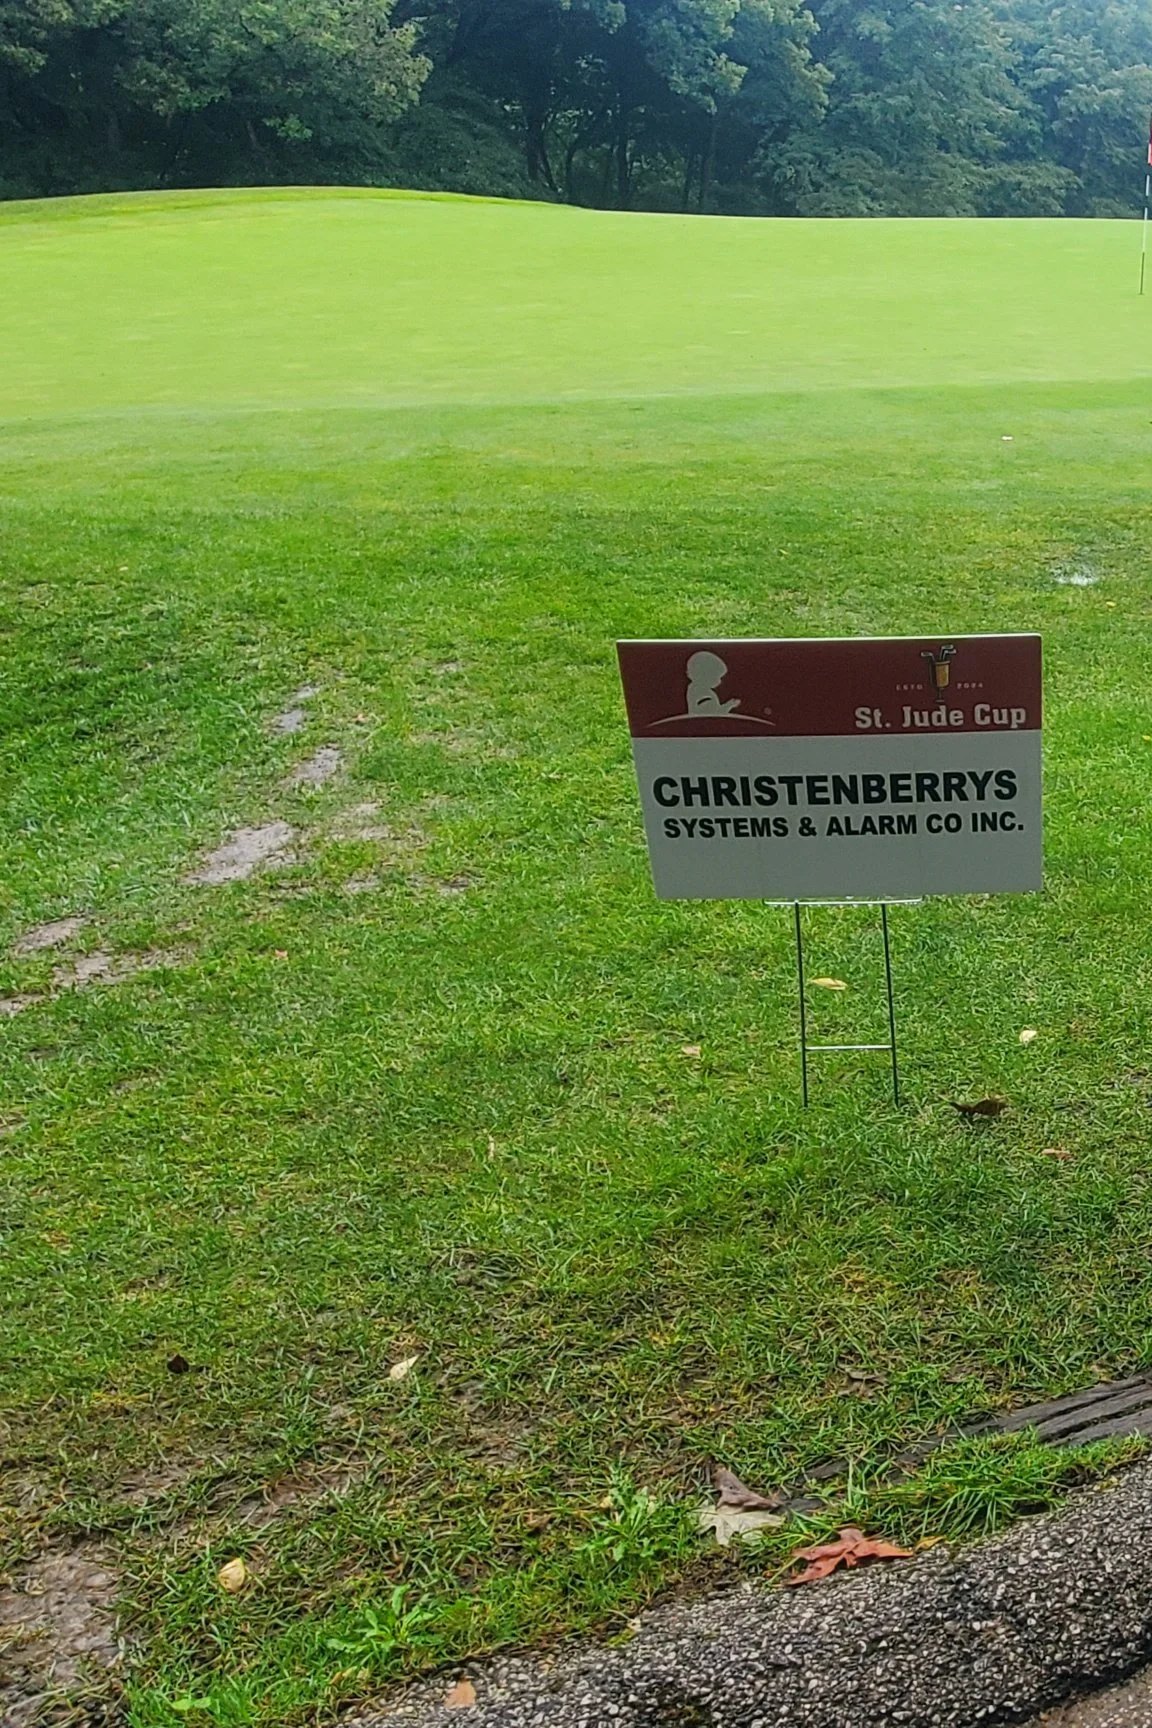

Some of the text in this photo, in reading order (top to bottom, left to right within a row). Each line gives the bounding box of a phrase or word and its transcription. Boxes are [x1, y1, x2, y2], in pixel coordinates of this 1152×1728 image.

[855, 703, 1026, 729] St. Jude Cup
[652, 770, 1018, 807] CHRISTENBERRYS
[664, 810, 1024, 839] SYSTEMS & ALARM CO INC.
